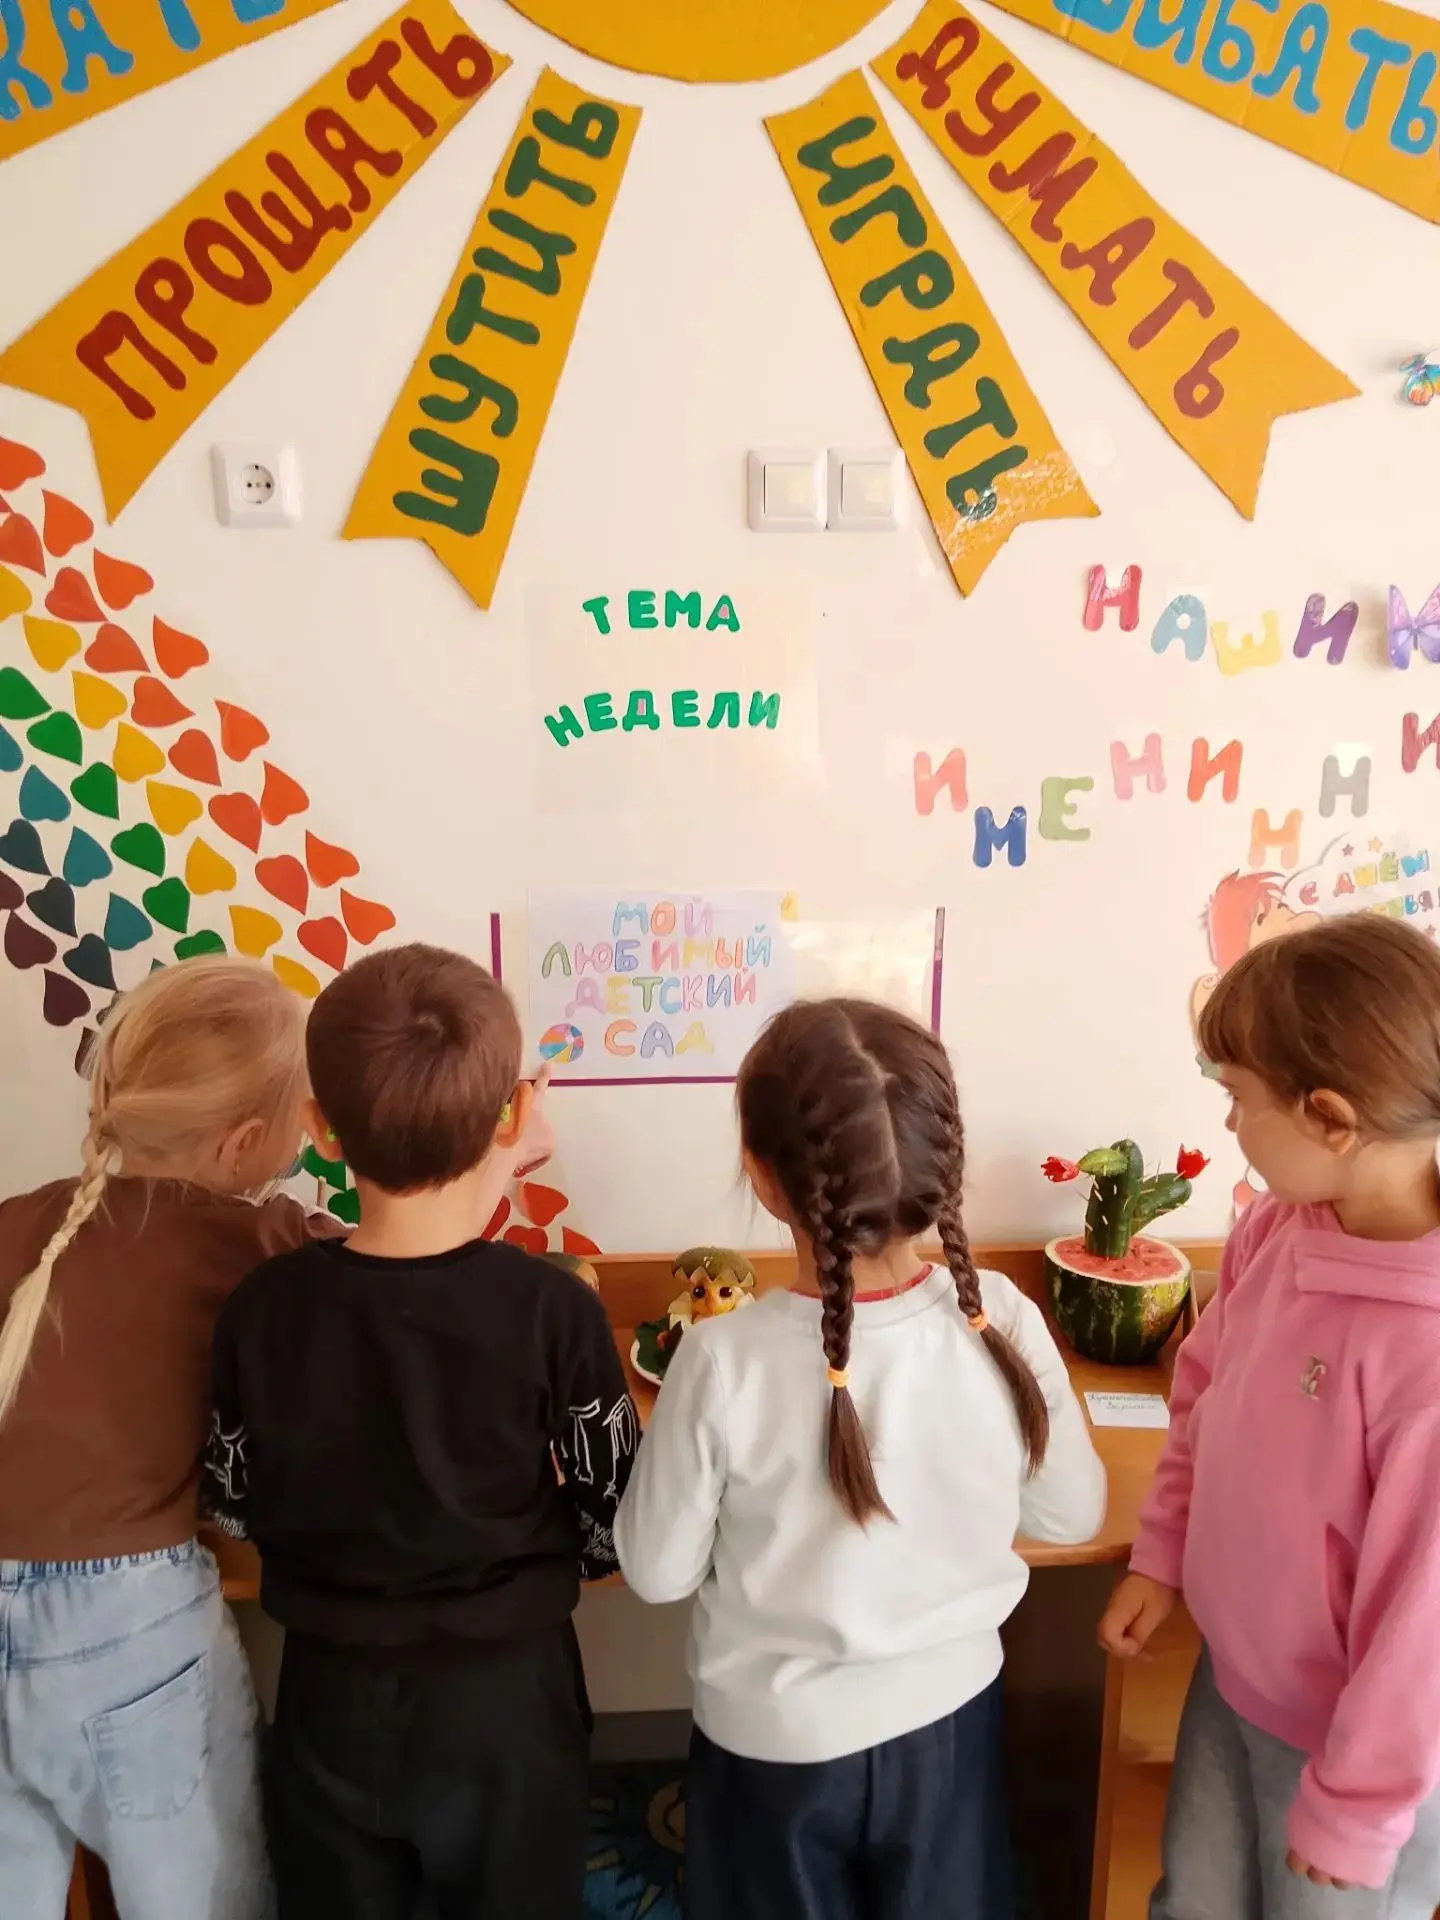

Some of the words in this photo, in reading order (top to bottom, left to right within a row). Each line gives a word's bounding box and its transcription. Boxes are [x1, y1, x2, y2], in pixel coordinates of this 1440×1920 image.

[77, 18, 494, 420] ПРОЩАТЬ
[896, 17, 1239, 418] ДУМАТЬ
[393, 101, 619, 536] ШУТИТЬ
[797, 116, 1028, 520] ИГРАТЬ
[583, 590, 740, 634] ТЕМА
[1083, 564, 1359, 676] НАШИ
[544, 690, 781, 747] НЕДЕЛИ
[612, 896, 714, 937] МОЙ
[541, 924, 772, 979] ЛЮБИМЫЙ
[565, 966, 757, 1018] ДЕТСКИЙ
[603, 1019, 715, 1059] САД
